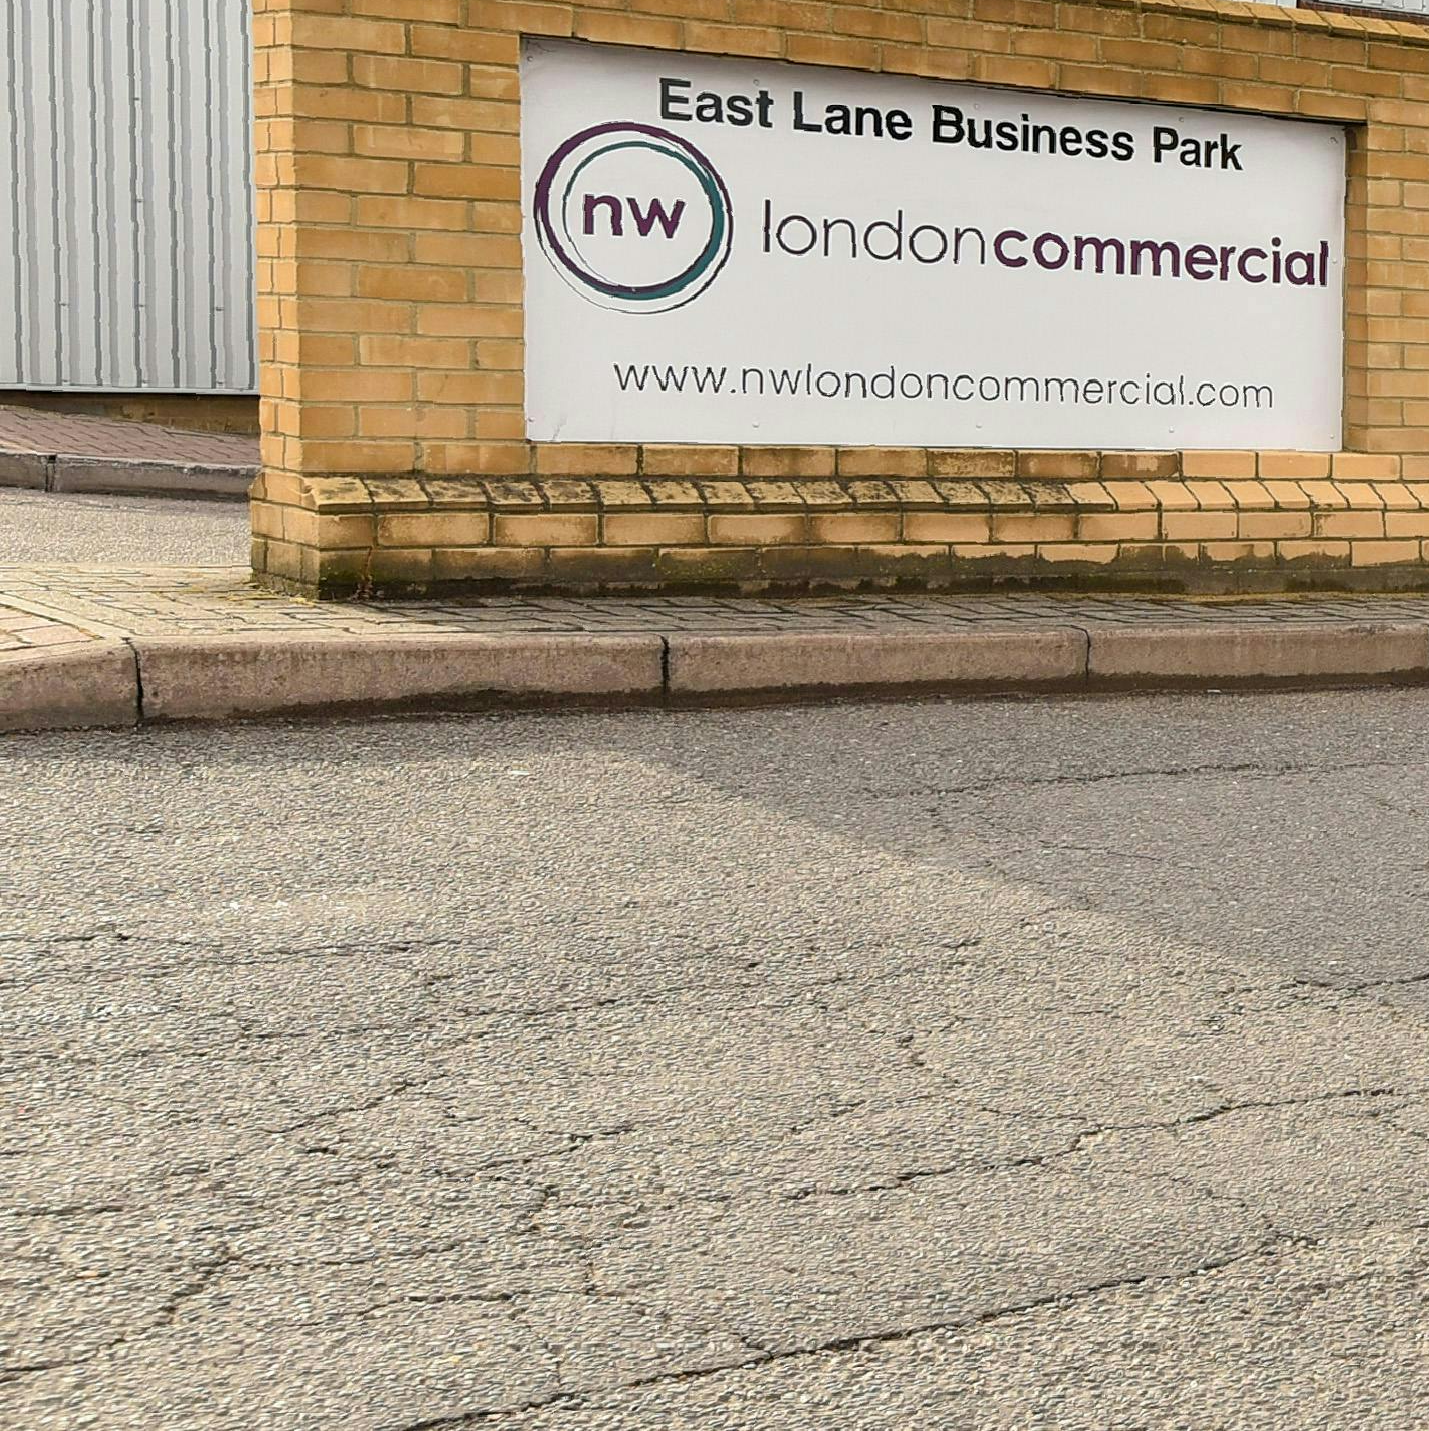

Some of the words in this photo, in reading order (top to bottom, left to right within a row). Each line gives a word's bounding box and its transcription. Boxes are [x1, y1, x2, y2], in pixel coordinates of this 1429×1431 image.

[658, 77, 774, 130] East
[792, 91, 913, 141] Lane
[931, 105, 1135, 162] Business
[1153, 126, 1244, 172] Park
[583, 190, 686, 240] nw
[763, 199, 1330, 288] londoncommercial
[614, 363, 1275, 410] www.nwlondoncommercial.com
